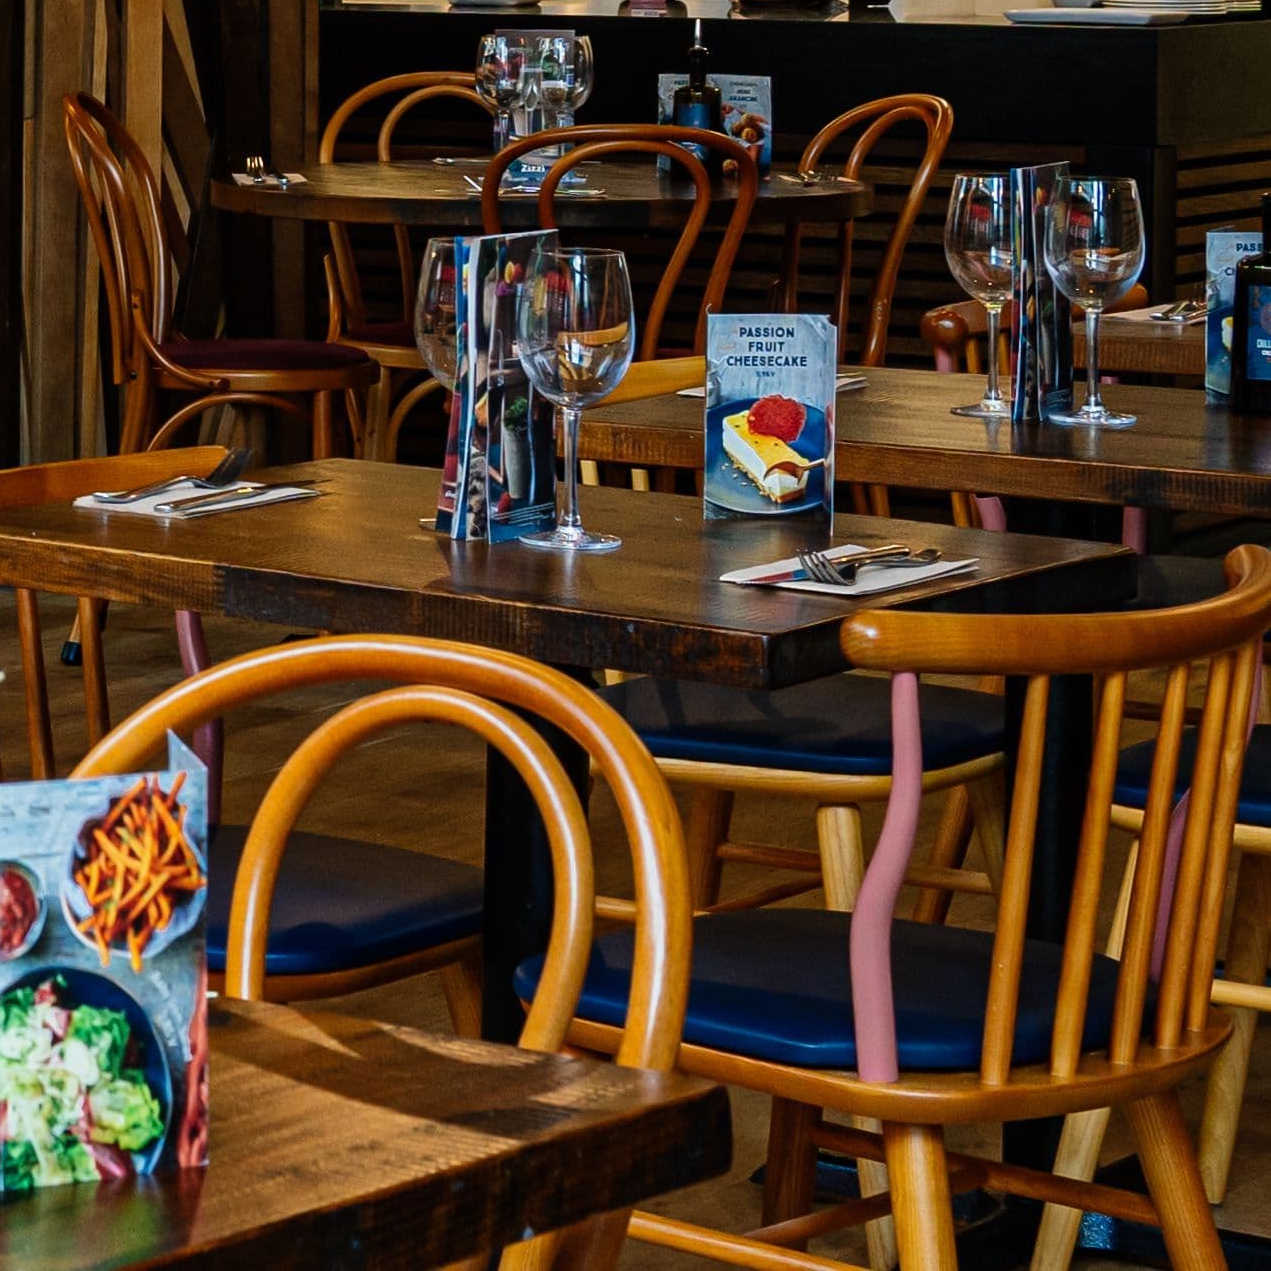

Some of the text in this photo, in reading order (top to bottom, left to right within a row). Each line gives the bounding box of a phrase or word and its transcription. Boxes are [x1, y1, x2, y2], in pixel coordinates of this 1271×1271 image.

[521, 163, 545, 173] Zizzi
[739, 326, 795, 338] PASSION
[748, 341, 785, 352] FRUIT
[726, 355, 808, 367] CHEESECAKE
